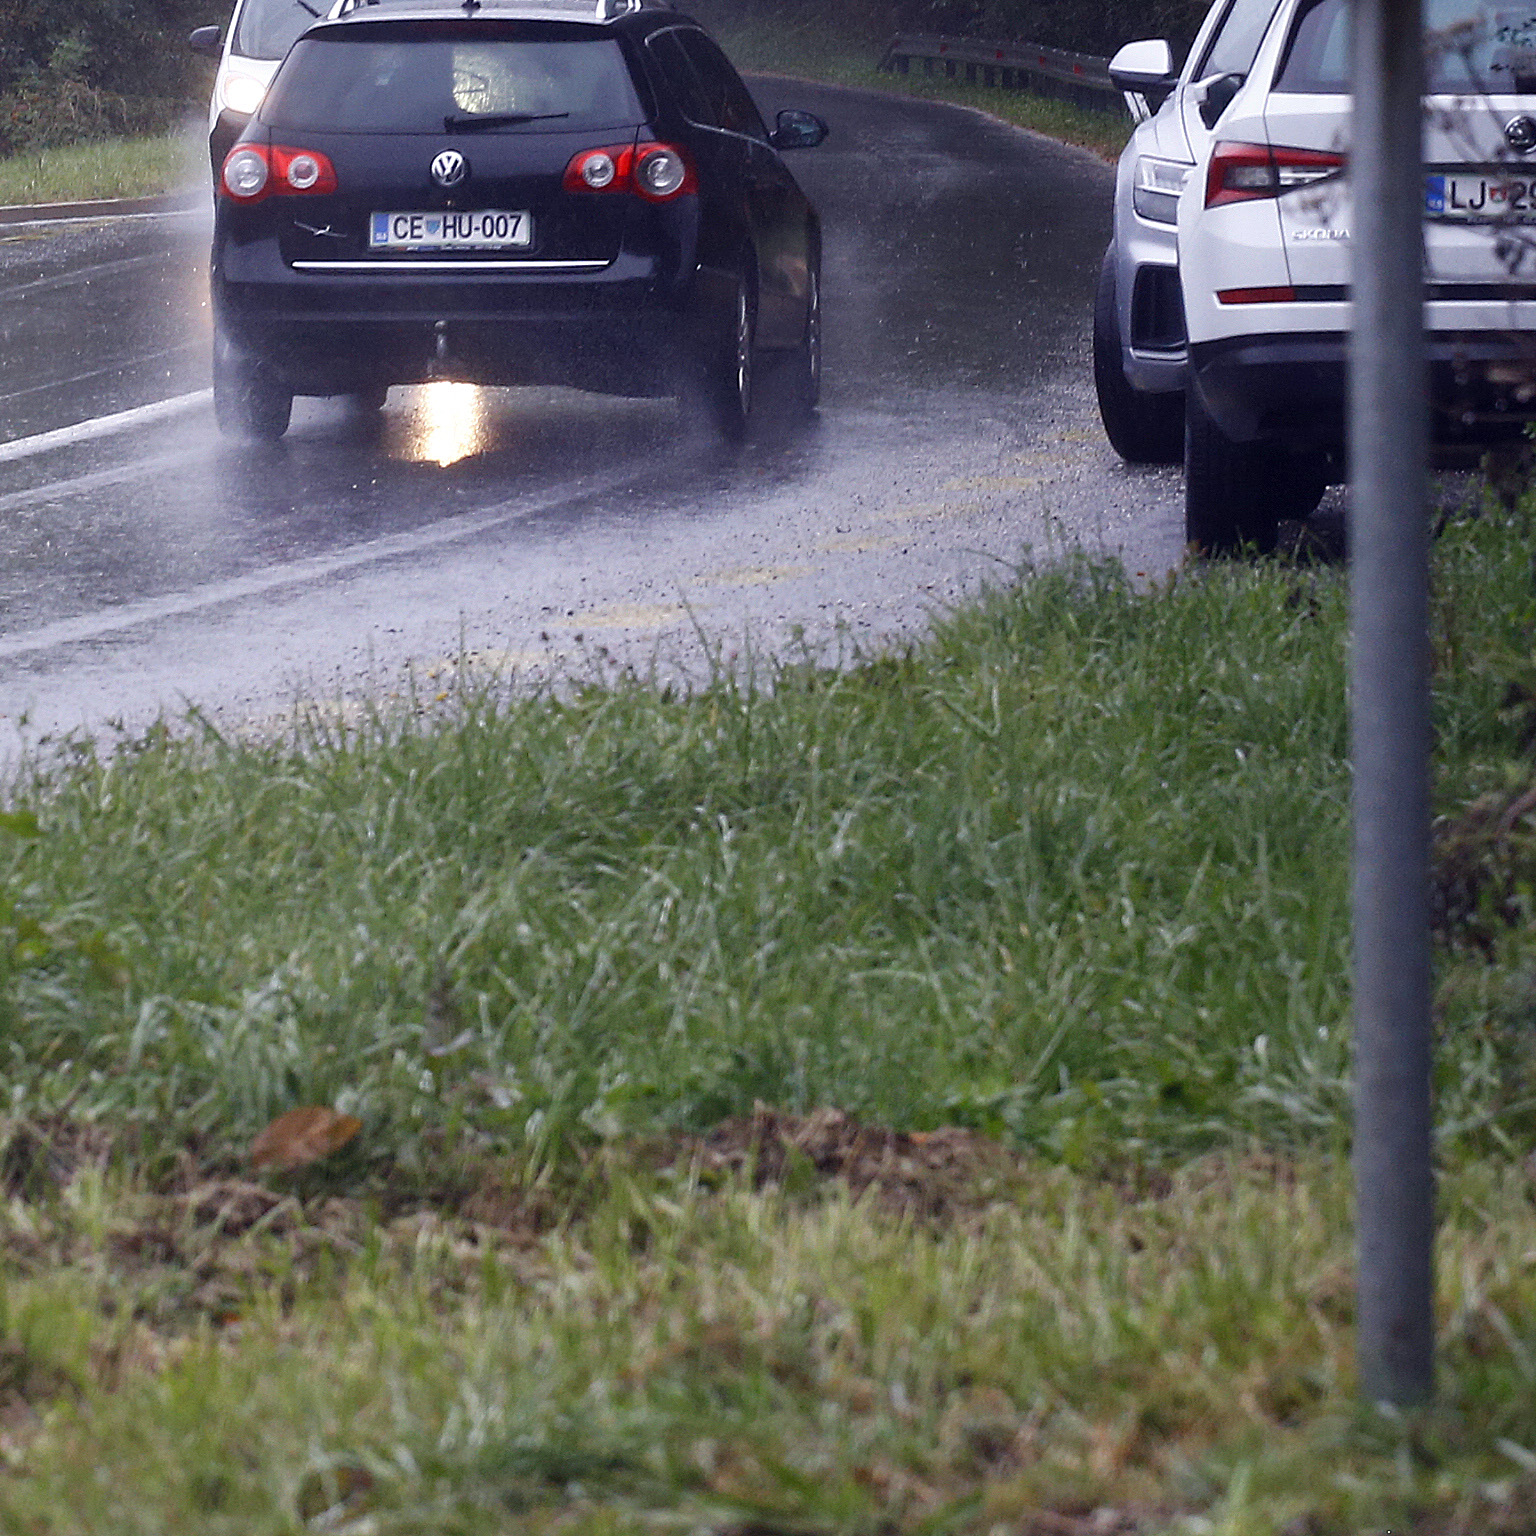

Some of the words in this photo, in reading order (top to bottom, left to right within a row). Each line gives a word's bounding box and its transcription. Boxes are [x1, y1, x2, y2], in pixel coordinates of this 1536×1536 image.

[1450, 180, 1486, 210] LJ
[393, 216, 423, 239] CE
[442, 215, 522, 239] HU-007
